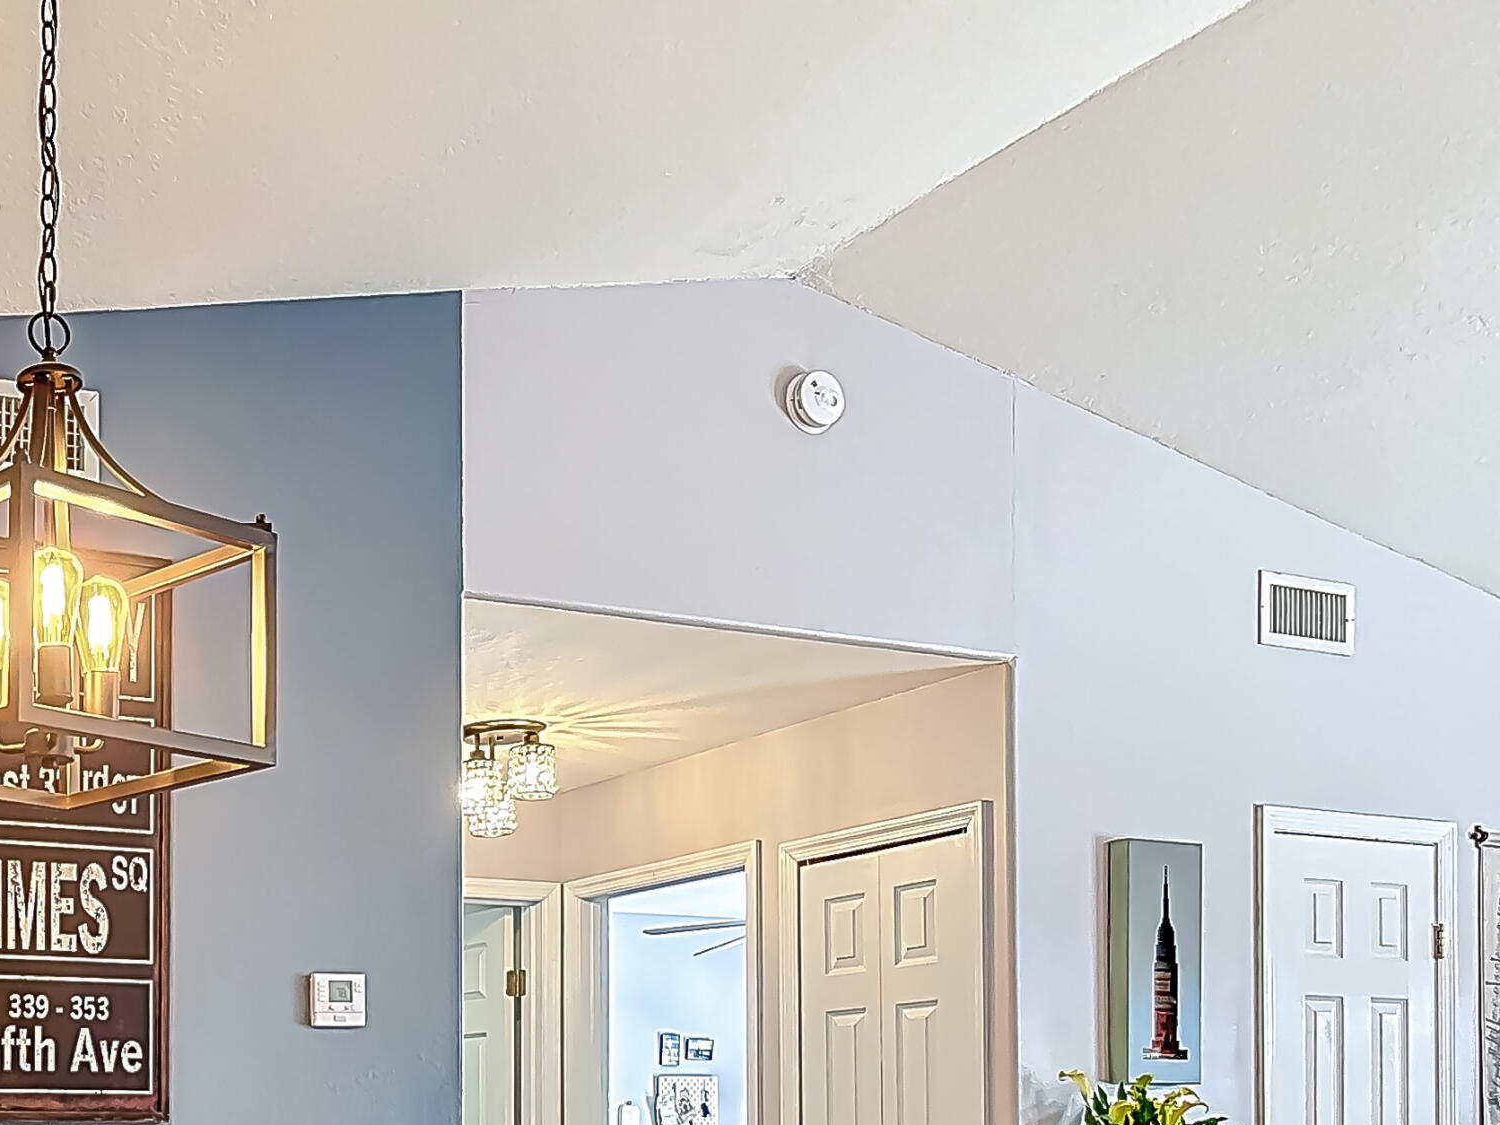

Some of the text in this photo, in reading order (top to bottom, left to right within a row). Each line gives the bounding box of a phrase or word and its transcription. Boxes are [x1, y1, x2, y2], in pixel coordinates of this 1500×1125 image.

[111, 855, 148, 892] SQ
[8, 994, 49, 1019] 339
[70, 996, 109, 1021] 353
[70, 1027, 143, 1073] Ave
